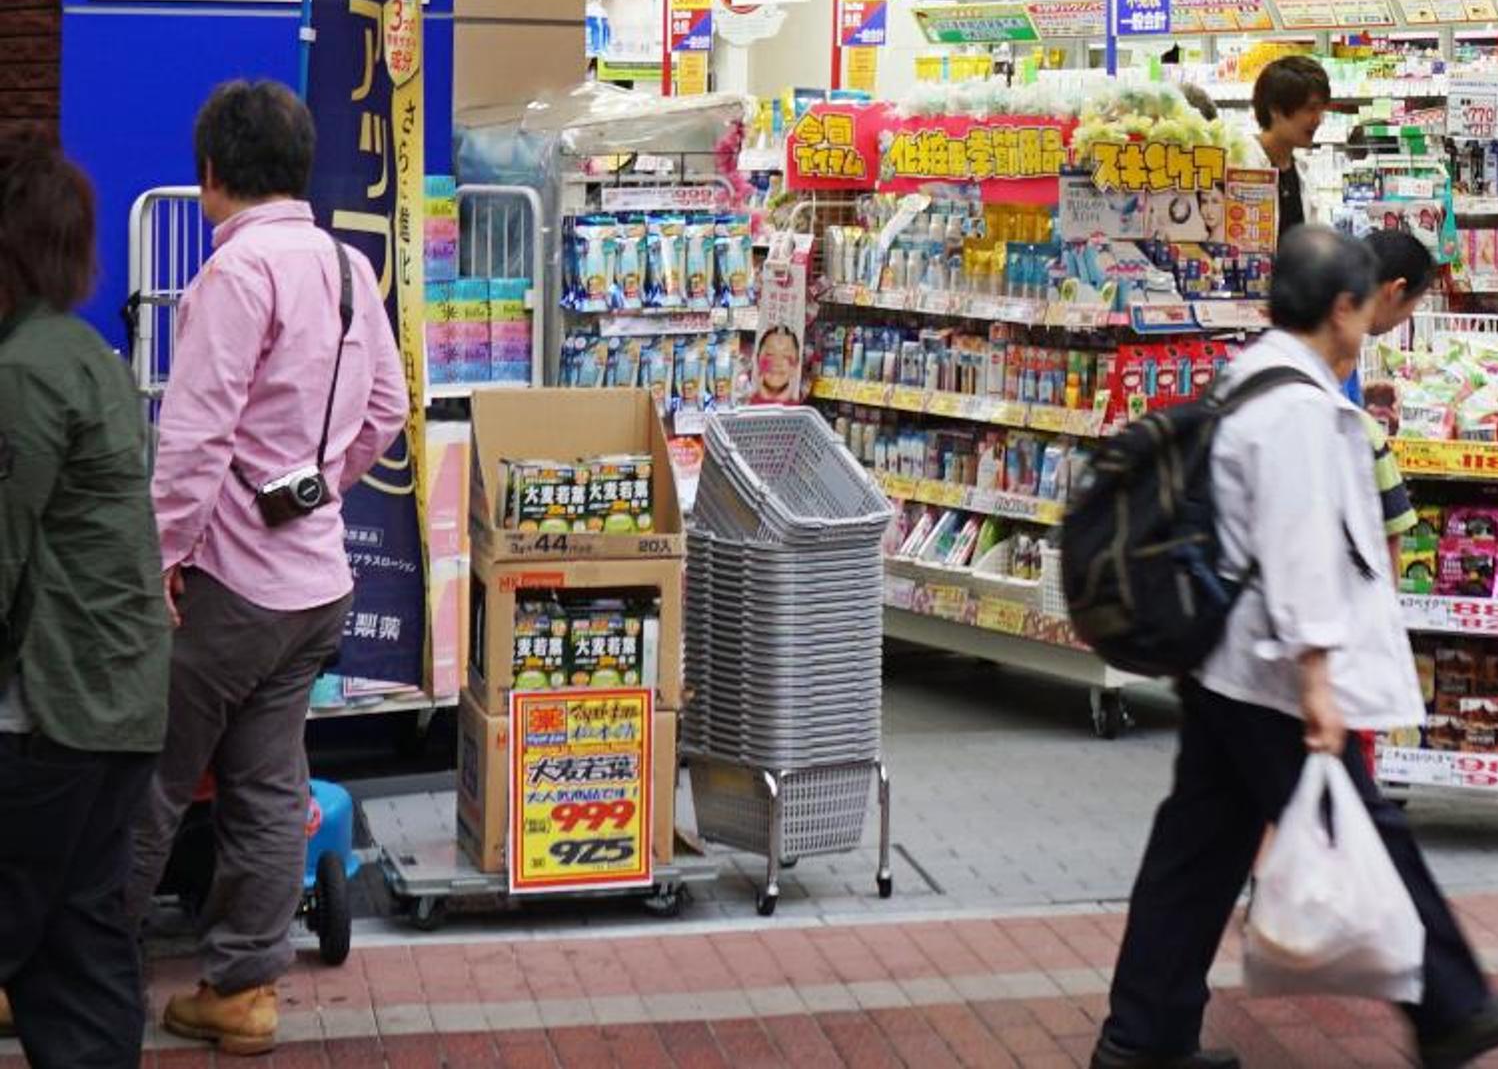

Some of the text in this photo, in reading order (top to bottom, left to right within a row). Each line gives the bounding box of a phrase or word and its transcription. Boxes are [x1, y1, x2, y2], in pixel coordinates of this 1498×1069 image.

[1092, 141, 1226, 192] スキンケア
[551, 799, 636, 832] 999
[549, 837, 635, 866] 925
